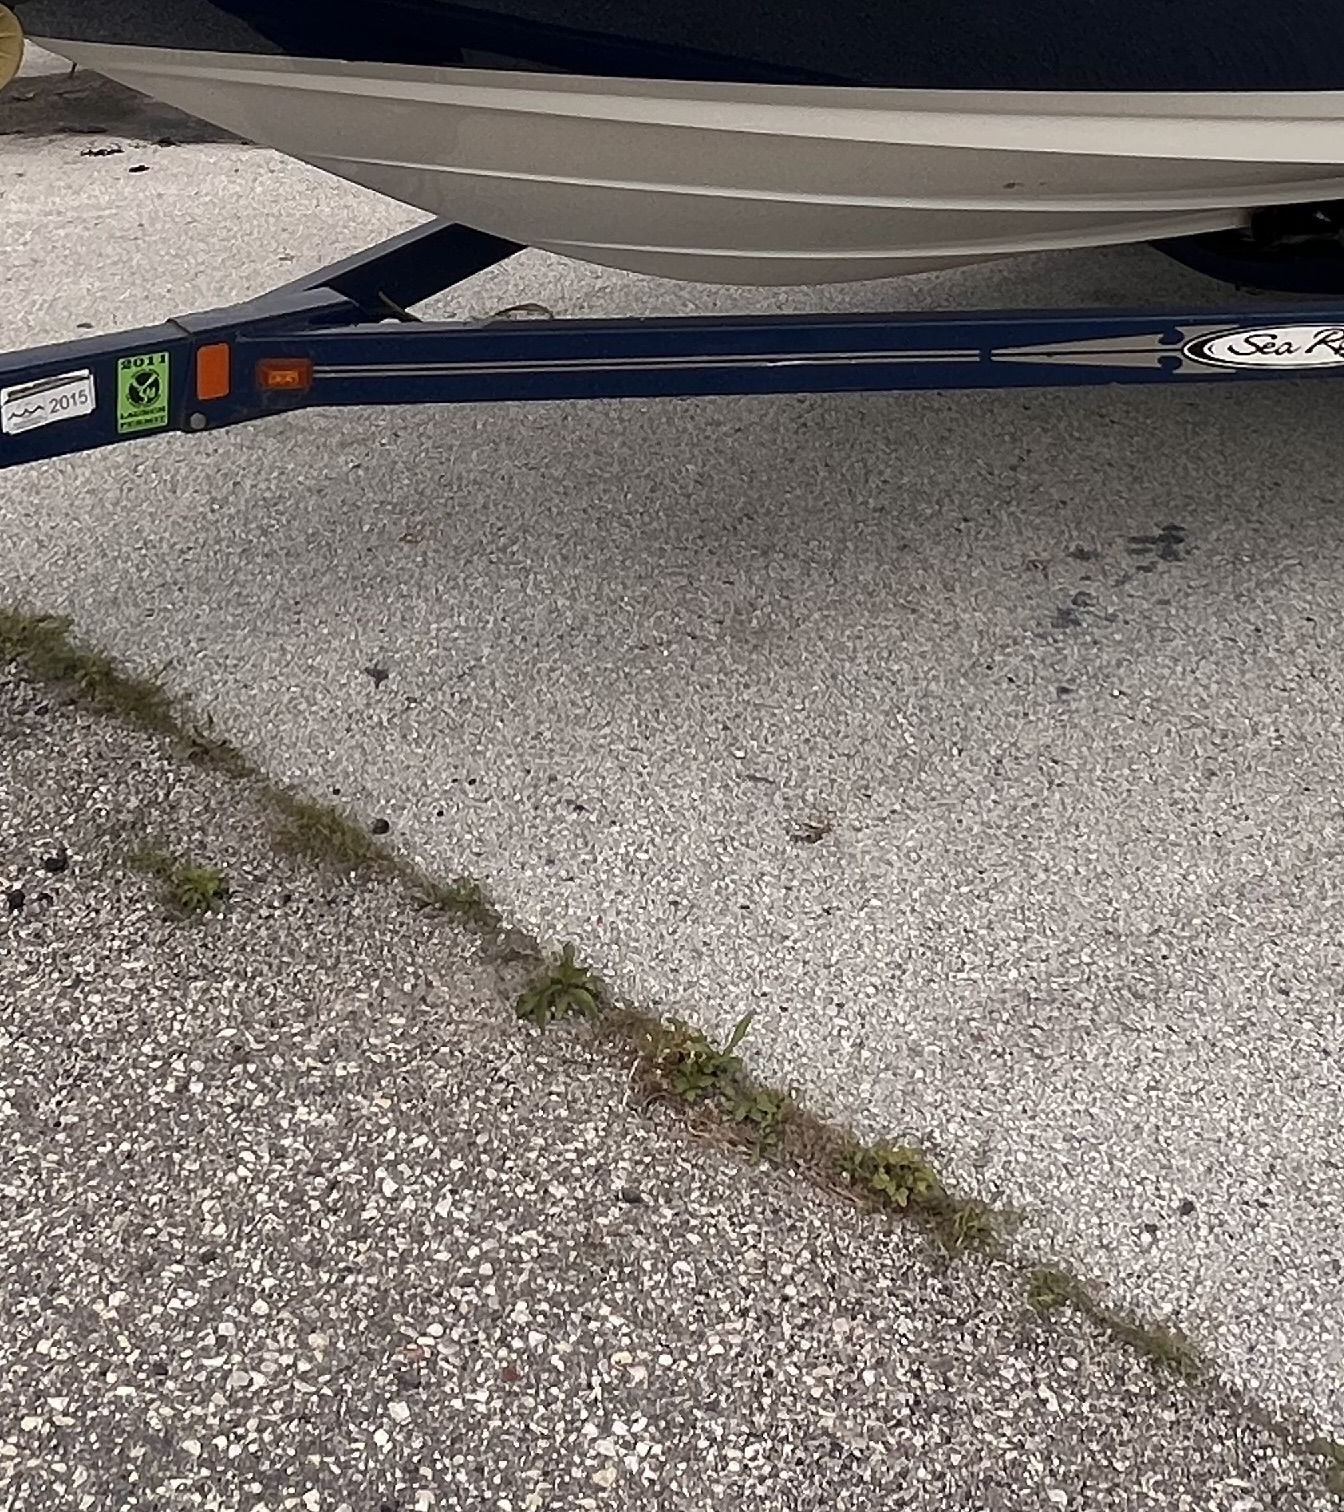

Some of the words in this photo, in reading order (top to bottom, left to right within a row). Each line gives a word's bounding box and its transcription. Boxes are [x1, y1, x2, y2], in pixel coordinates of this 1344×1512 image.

[1227, 333, 1301, 356] Sea
[120, 354, 167, 370] 2011
[48, 390, 89, 414] 2015
